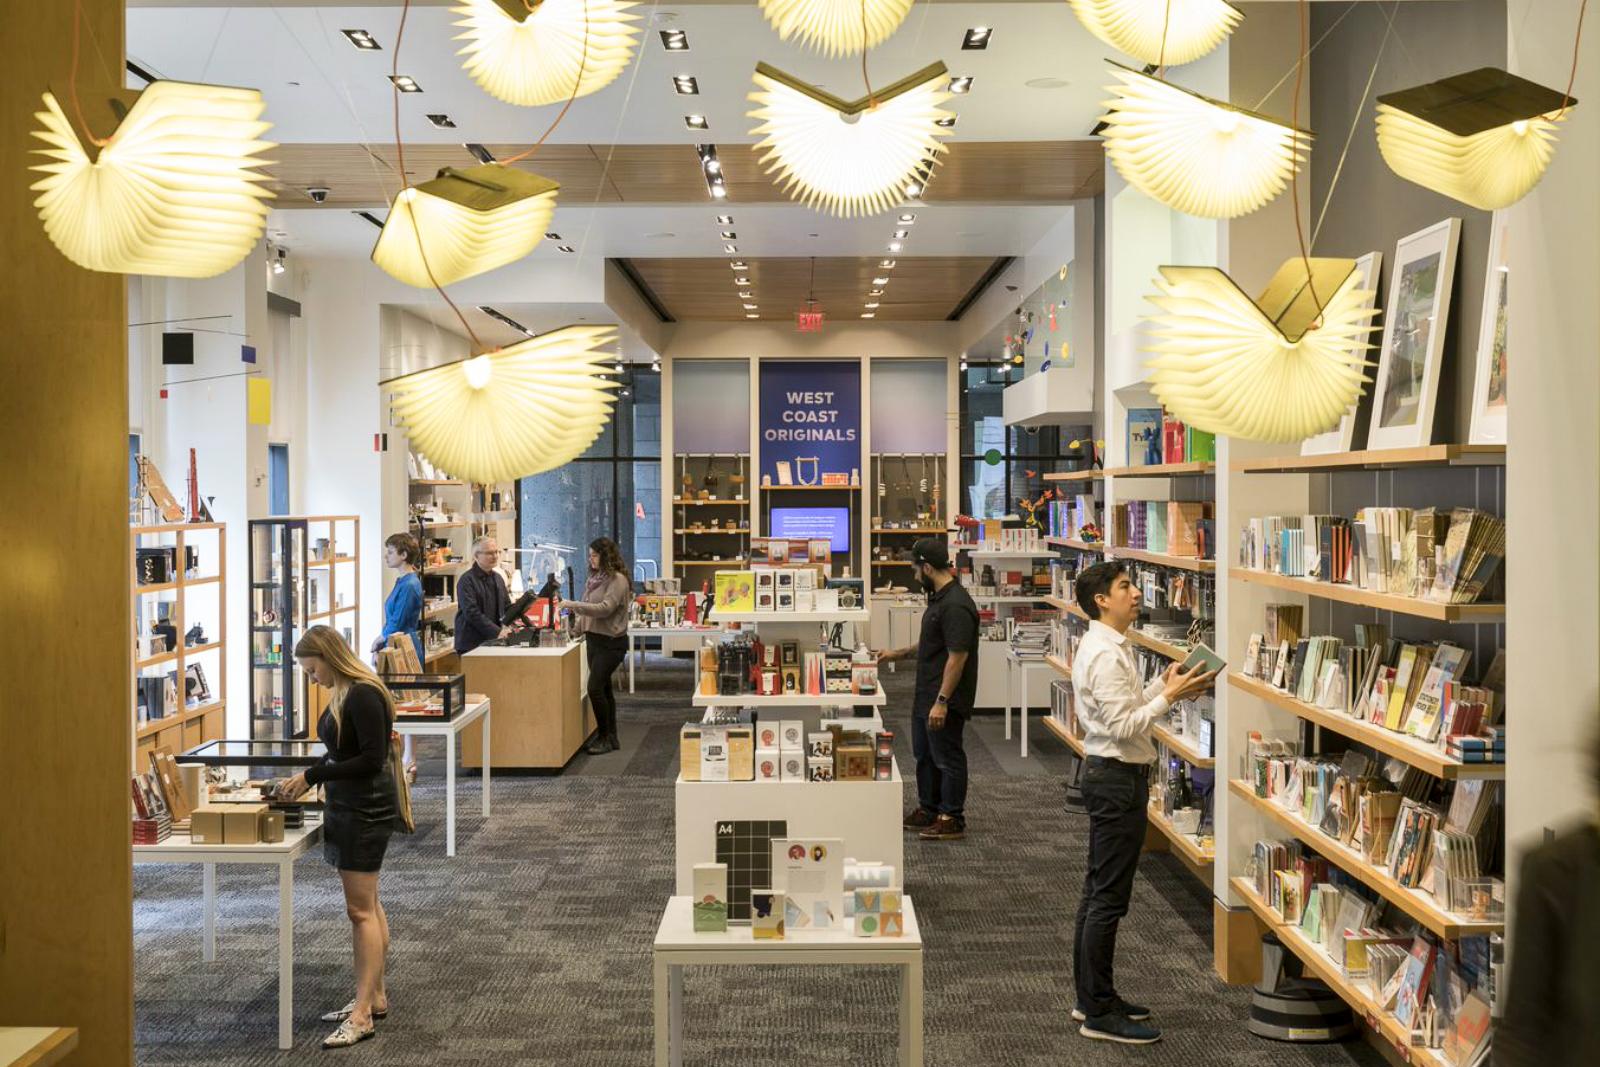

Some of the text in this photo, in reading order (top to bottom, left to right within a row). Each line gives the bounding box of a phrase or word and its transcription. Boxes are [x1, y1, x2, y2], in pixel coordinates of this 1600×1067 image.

[800, 313, 823, 330] EXIT
[786, 392, 834, 404] WEST
[782, 410, 838, 423] COAST
[765, 429, 856, 441] ORIGINALS
[718, 824, 733, 834] A4
